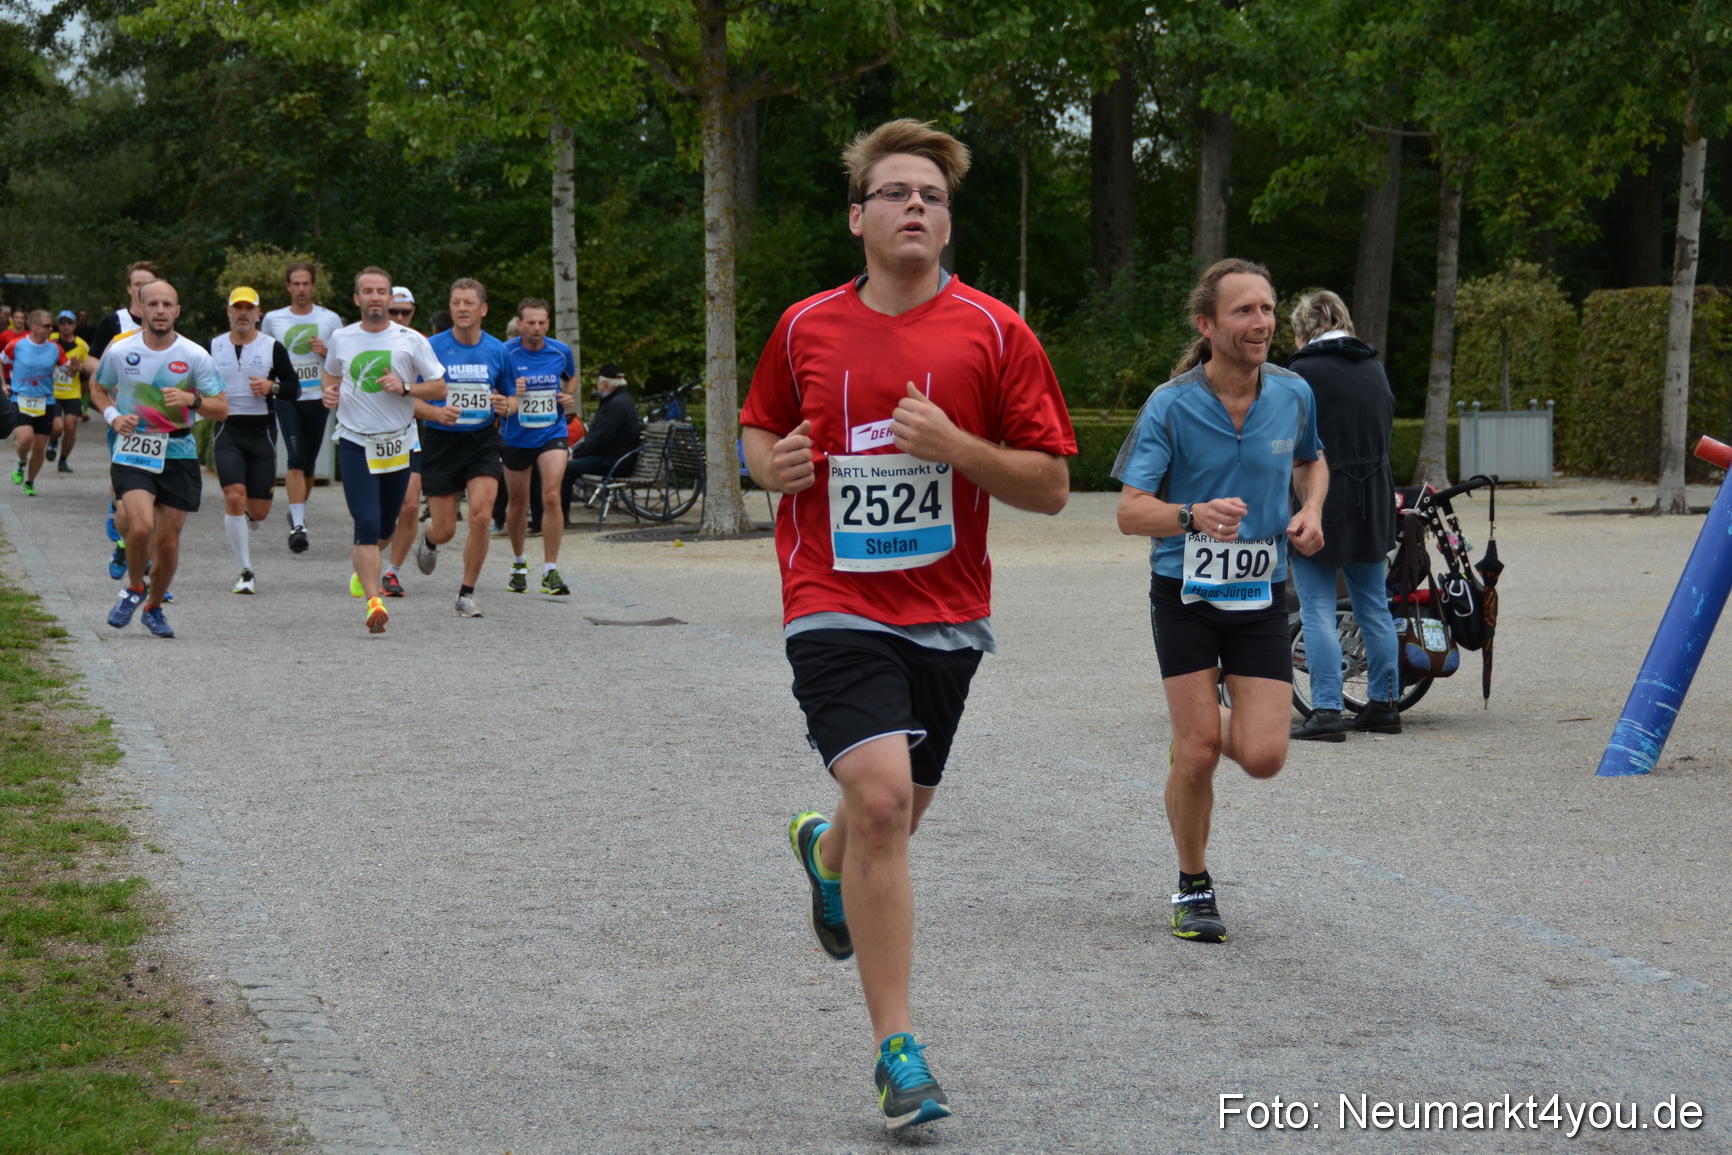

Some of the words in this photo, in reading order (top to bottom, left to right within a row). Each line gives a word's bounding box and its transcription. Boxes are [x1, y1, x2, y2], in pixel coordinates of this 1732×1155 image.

[296, 366, 319, 379] 008
[448, 364, 488, 374] HUBER
[526, 374, 557, 385] YSCAD
[26, 399, 38, 408] 57
[452, 393, 487, 408] 2545
[523, 399, 553, 413] 2213
[870, 427, 898, 441] DER
[121, 436, 162, 456] 2263
[376, 439, 402, 457] 508
[125, 456, 151, 466] Richard
[831, 467, 868, 478] PARTL
[871, 464, 931, 477] Neumarkt
[840, 480, 942, 526] 2524
[835, 523, 841, 531] A
[865, 537, 918, 555] Stefan
[1194, 547, 1270, 580] 2190
[1191, 585, 1262, 600] Hans-Jürgen
